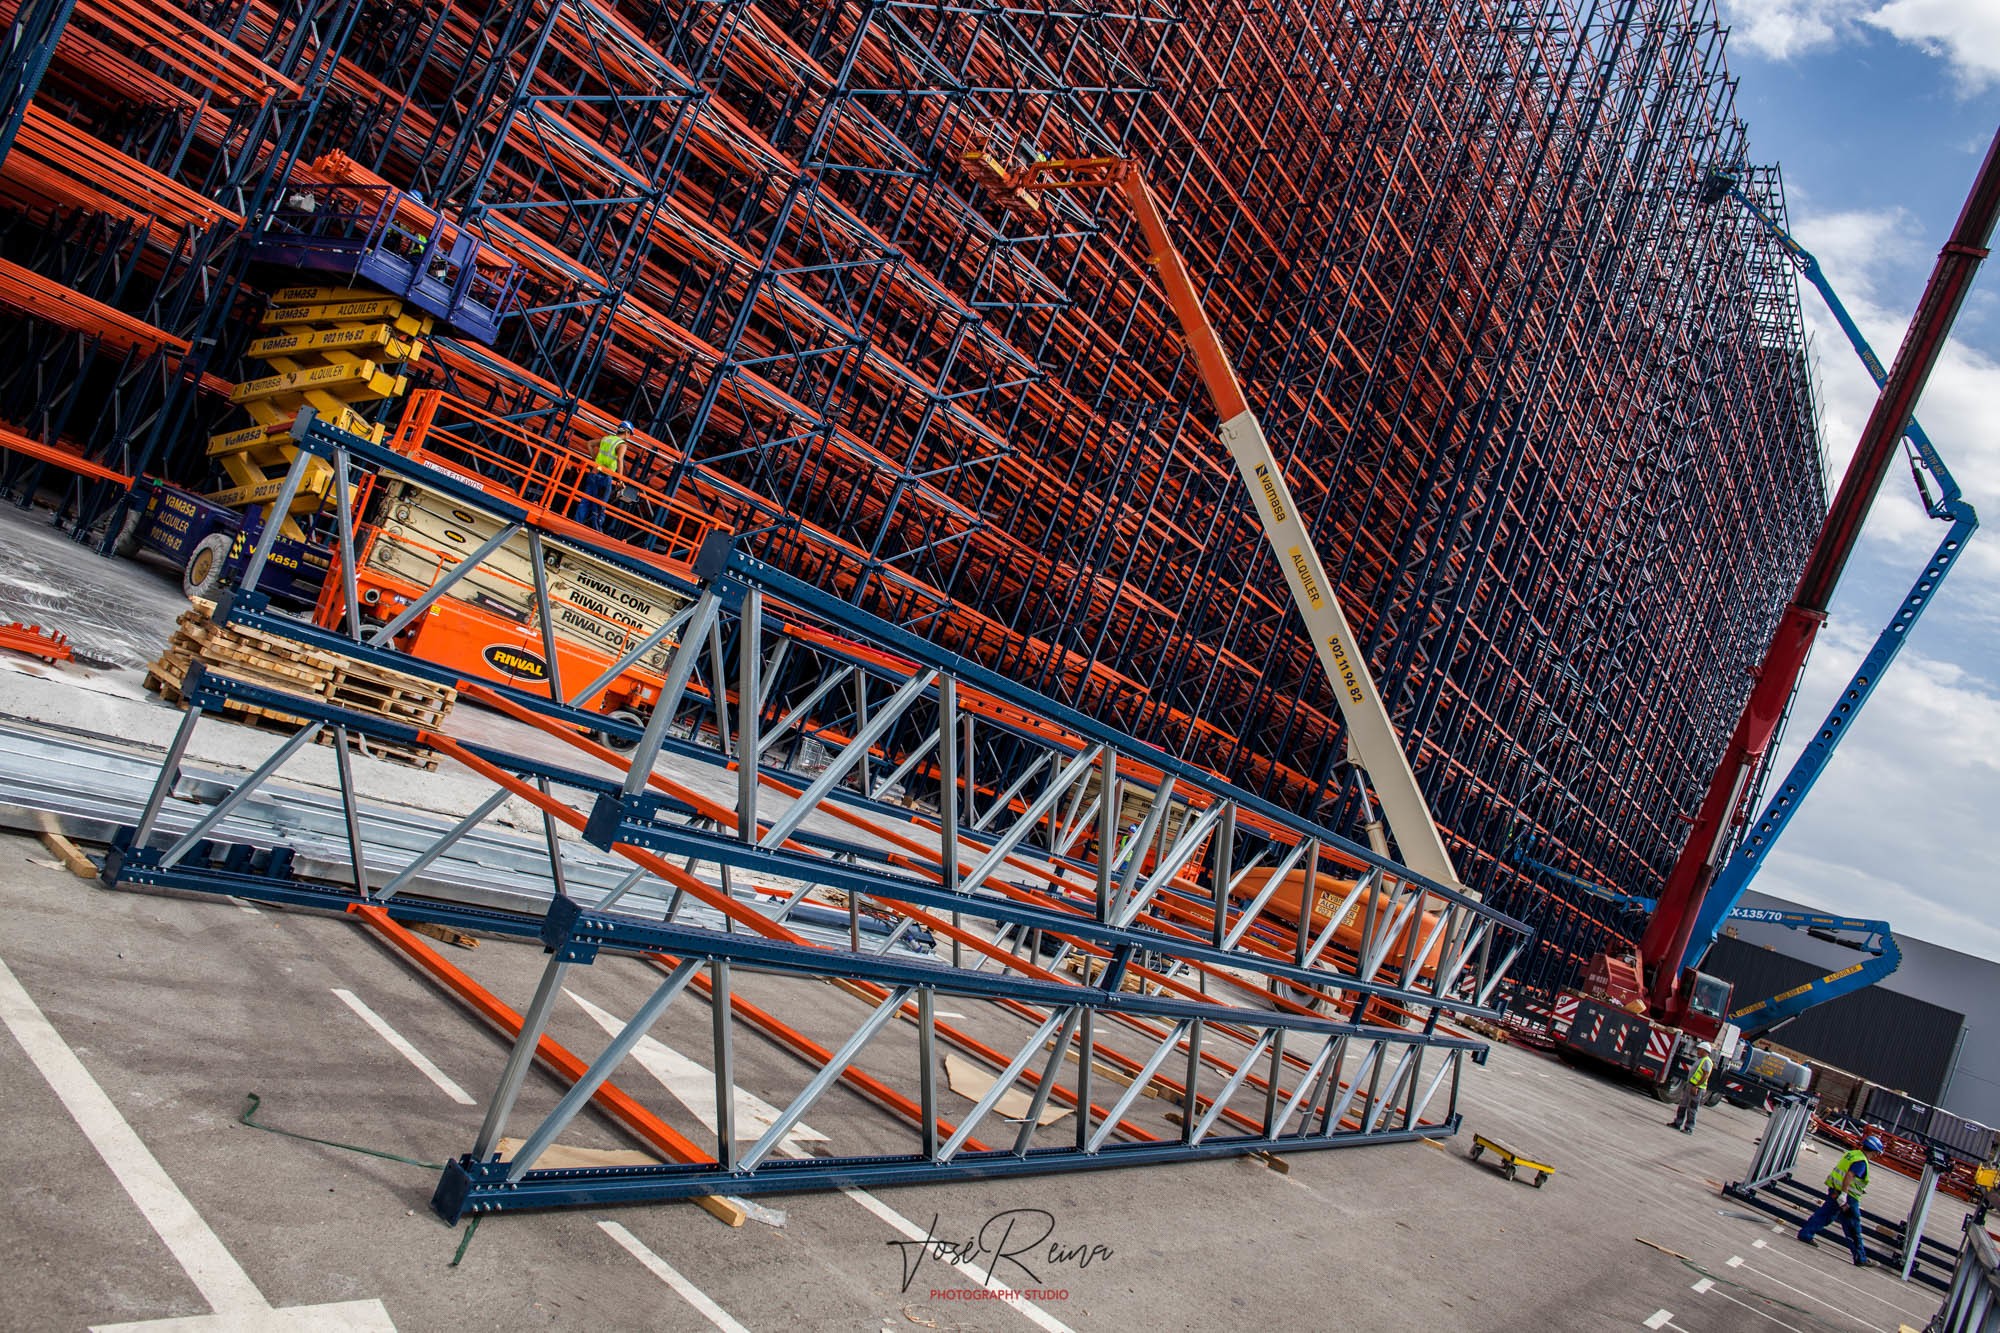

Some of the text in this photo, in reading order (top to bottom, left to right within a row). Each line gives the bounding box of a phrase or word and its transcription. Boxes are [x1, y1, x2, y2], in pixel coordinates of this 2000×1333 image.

[337, 302, 378, 314] ALQUILER
[322, 332, 336, 344] 902
[336, 331, 344, 342] 11
[343, 330, 354, 341] 96
[354, 329, 364, 340] 82
[308, 365, 344, 380] ALQUILER
[158, 511, 190, 534] ALQUILER
[576, 572, 651, 614] RIWAL.COM
[1262, 475, 1363, 704] vamasa ALQUILER 902 11 96 82
[562, 610, 636, 652] RIWAL.COM
[493, 650, 543, 676] RIWAL
[1728, 908, 1782, 920] X-135/70
